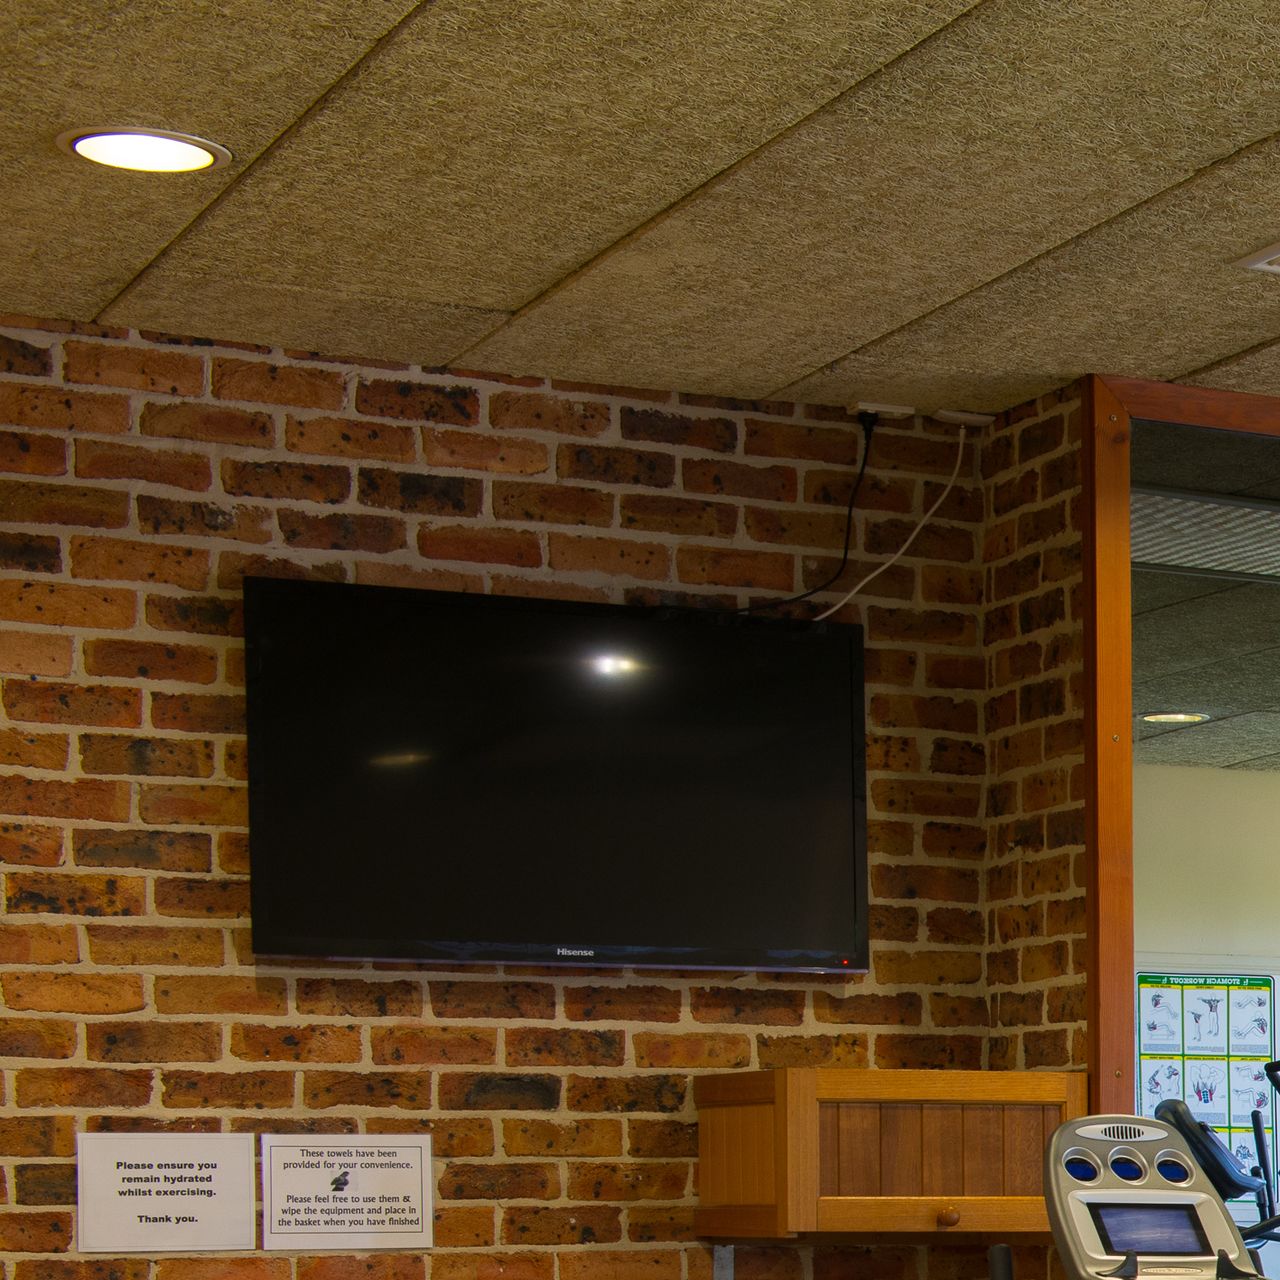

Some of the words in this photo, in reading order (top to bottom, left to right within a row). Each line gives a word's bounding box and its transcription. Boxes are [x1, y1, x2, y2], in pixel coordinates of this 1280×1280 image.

[557, 948, 594, 956] Hisense
[300, 1149, 324, 1157] These
[327, 1149, 353, 1157] towels
[356, 1149, 375, 1157] have
[377, 1149, 397, 1157] been
[116, 1161, 154, 1170] Please
[157, 1162, 195, 1170] ensure
[197, 1162, 217, 1171] you
[283, 1161, 320, 1170] provided
[323, 1161, 336, 1169] for
[338, 1162, 357, 1170] your
[360, 1161, 413, 1169] convenience.
[121, 1175, 160, 1183] remain
[163, 1175, 212, 1184] hydrated
[118, 1188, 152, 1196] whilst
[155, 1187, 216, 1198] exercising.
[286, 1195, 311, 1203] Please
[314, 1195, 329, 1203] feel
[332, 1195, 348, 1203] free
[379, 1195, 399, 1203] them
[402, 1195, 411, 1203] &
[281, 1207, 301, 1215] wipe
[320, 1207, 364, 1216] equipment
[367, 1206, 382, 1214] and
[385, 1206, 406, 1215] place
[408, 1206, 416, 1214] in
[137, 1215, 172, 1223] Thank
[175, 1216, 198, 1224] you.
[294, 1218, 320, 1226] basket
[323, 1218, 345, 1226] when
[348, 1219, 364, 1227] you
[388, 1217, 420, 1225] finished
